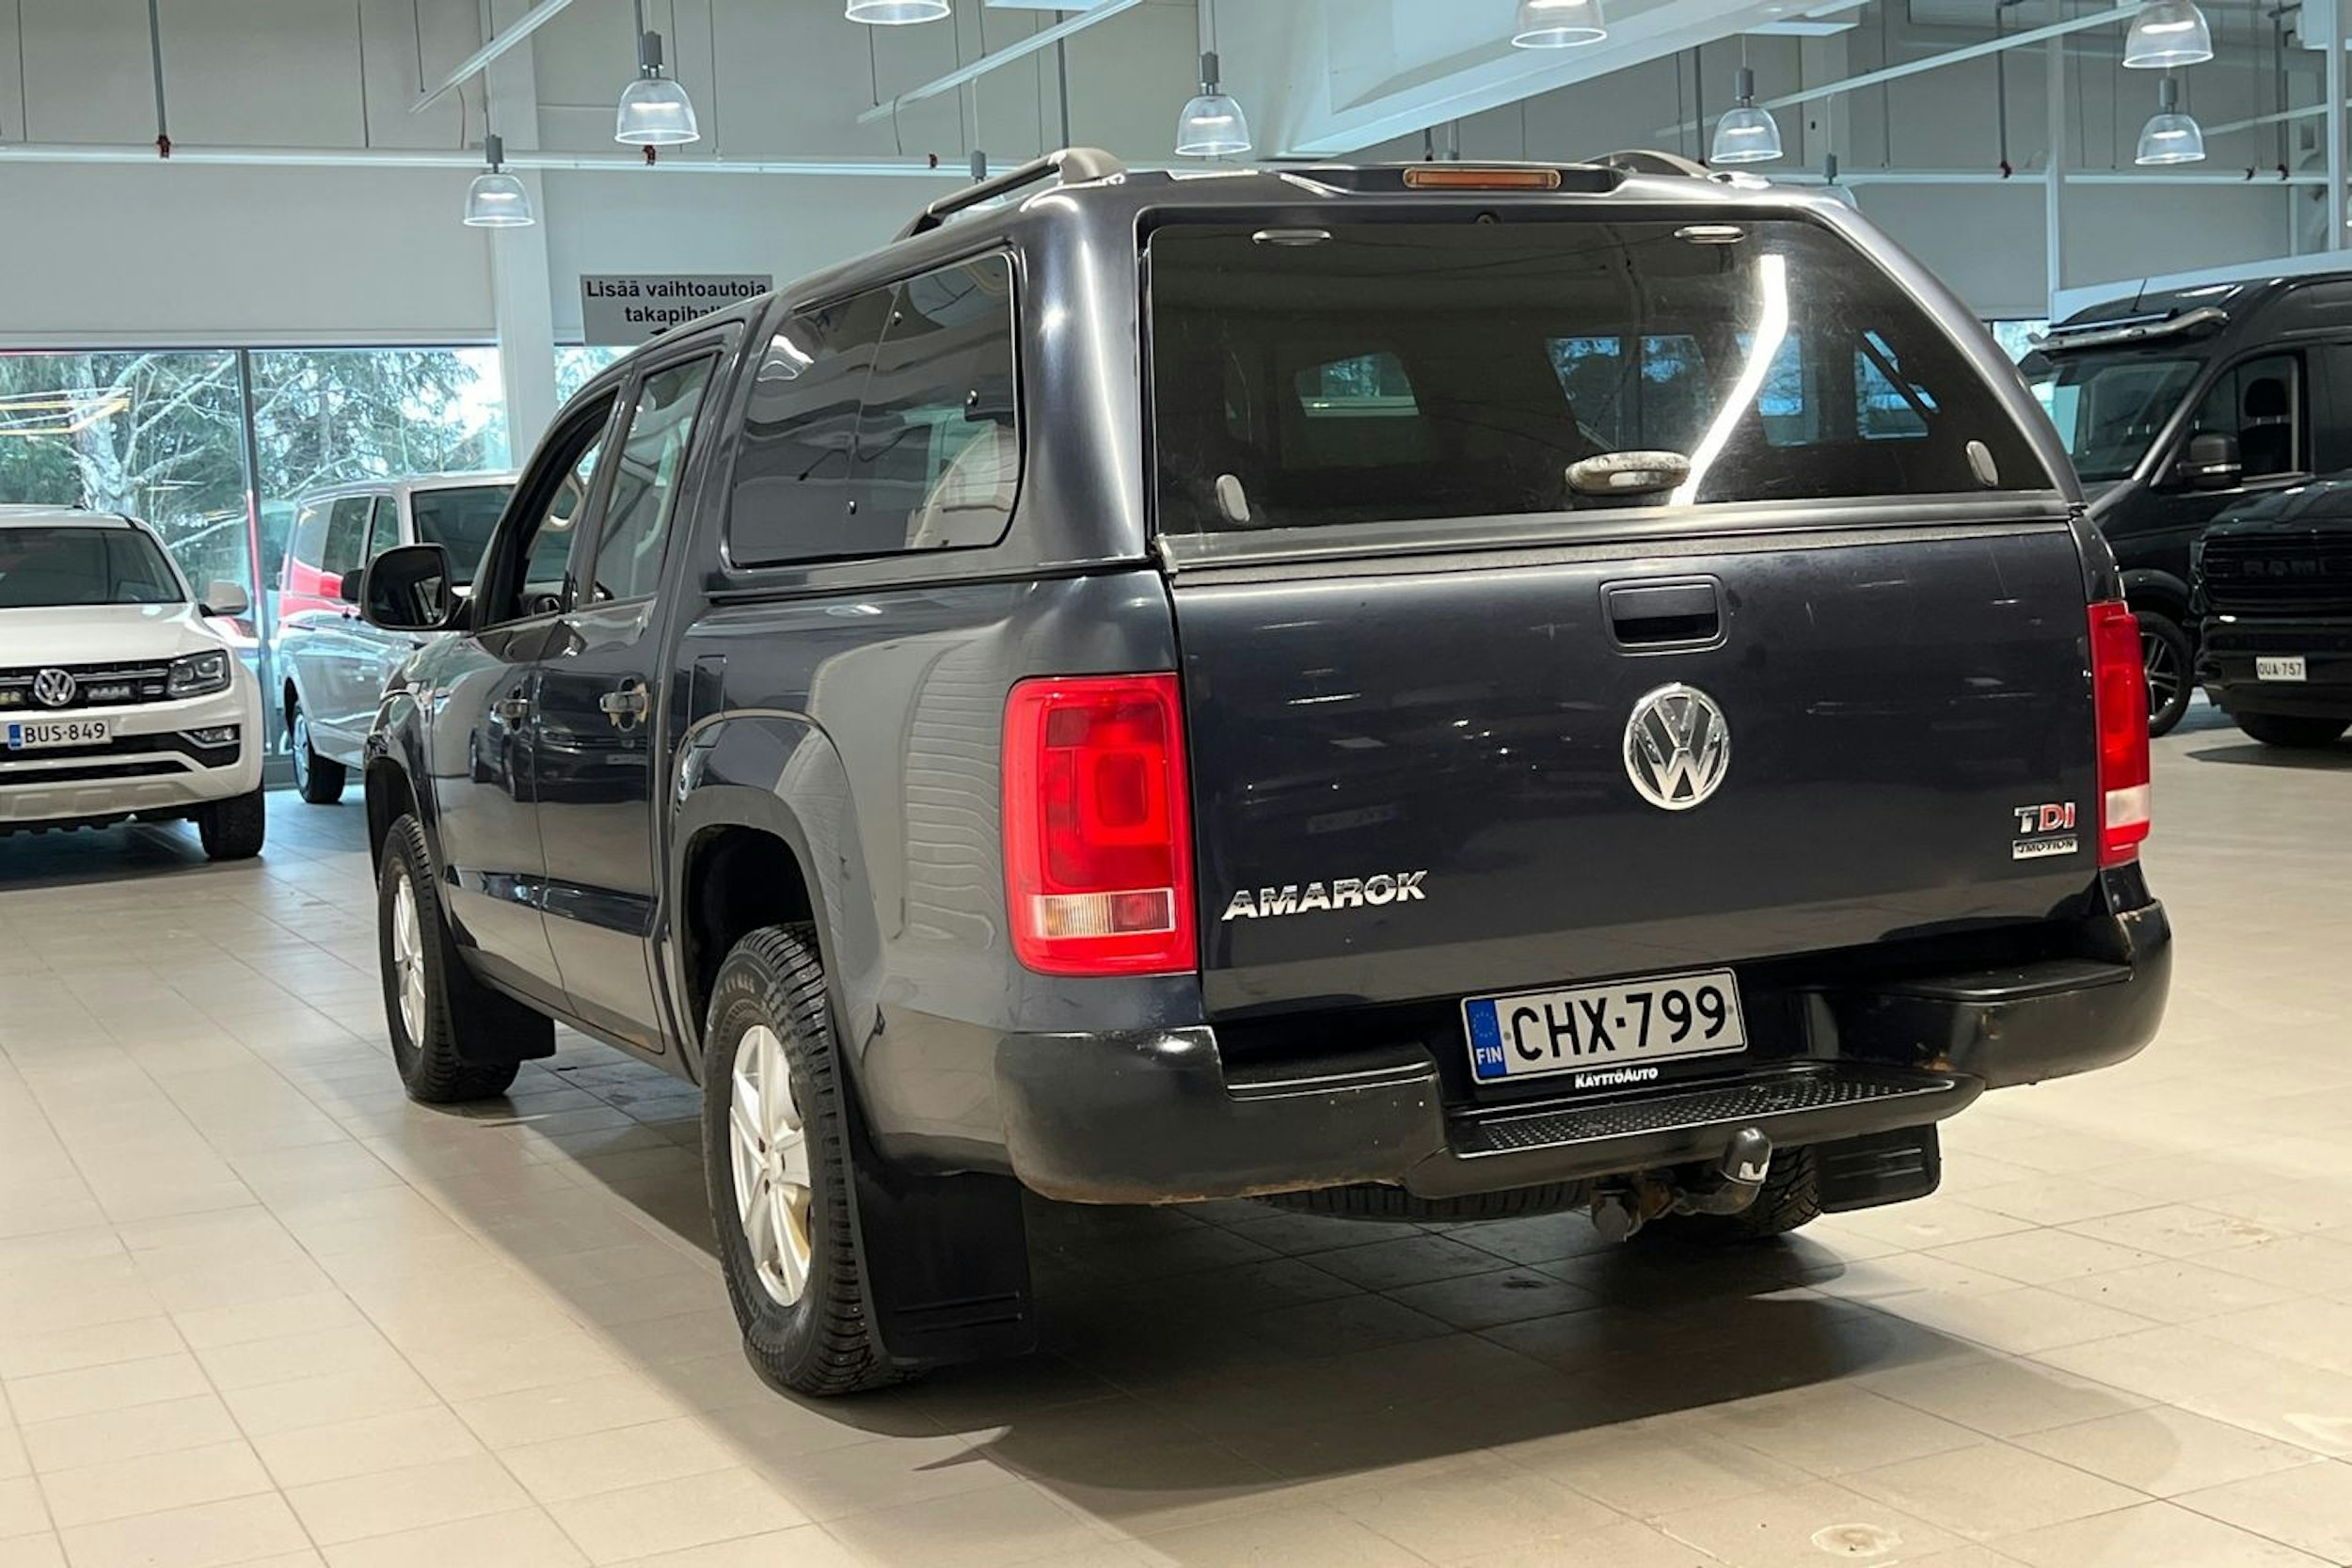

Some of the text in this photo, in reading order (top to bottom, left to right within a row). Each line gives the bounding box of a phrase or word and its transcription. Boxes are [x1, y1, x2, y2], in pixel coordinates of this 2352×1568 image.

[586, 281, 766, 298] Lisää vaihtoautoja
[24, 722, 105, 743] BUS-849
[2013, 802, 2075, 833] TDI
[1221, 870, 1427, 921] AMAROK
[1476, 986, 1725, 1065] FIN CHX-799
